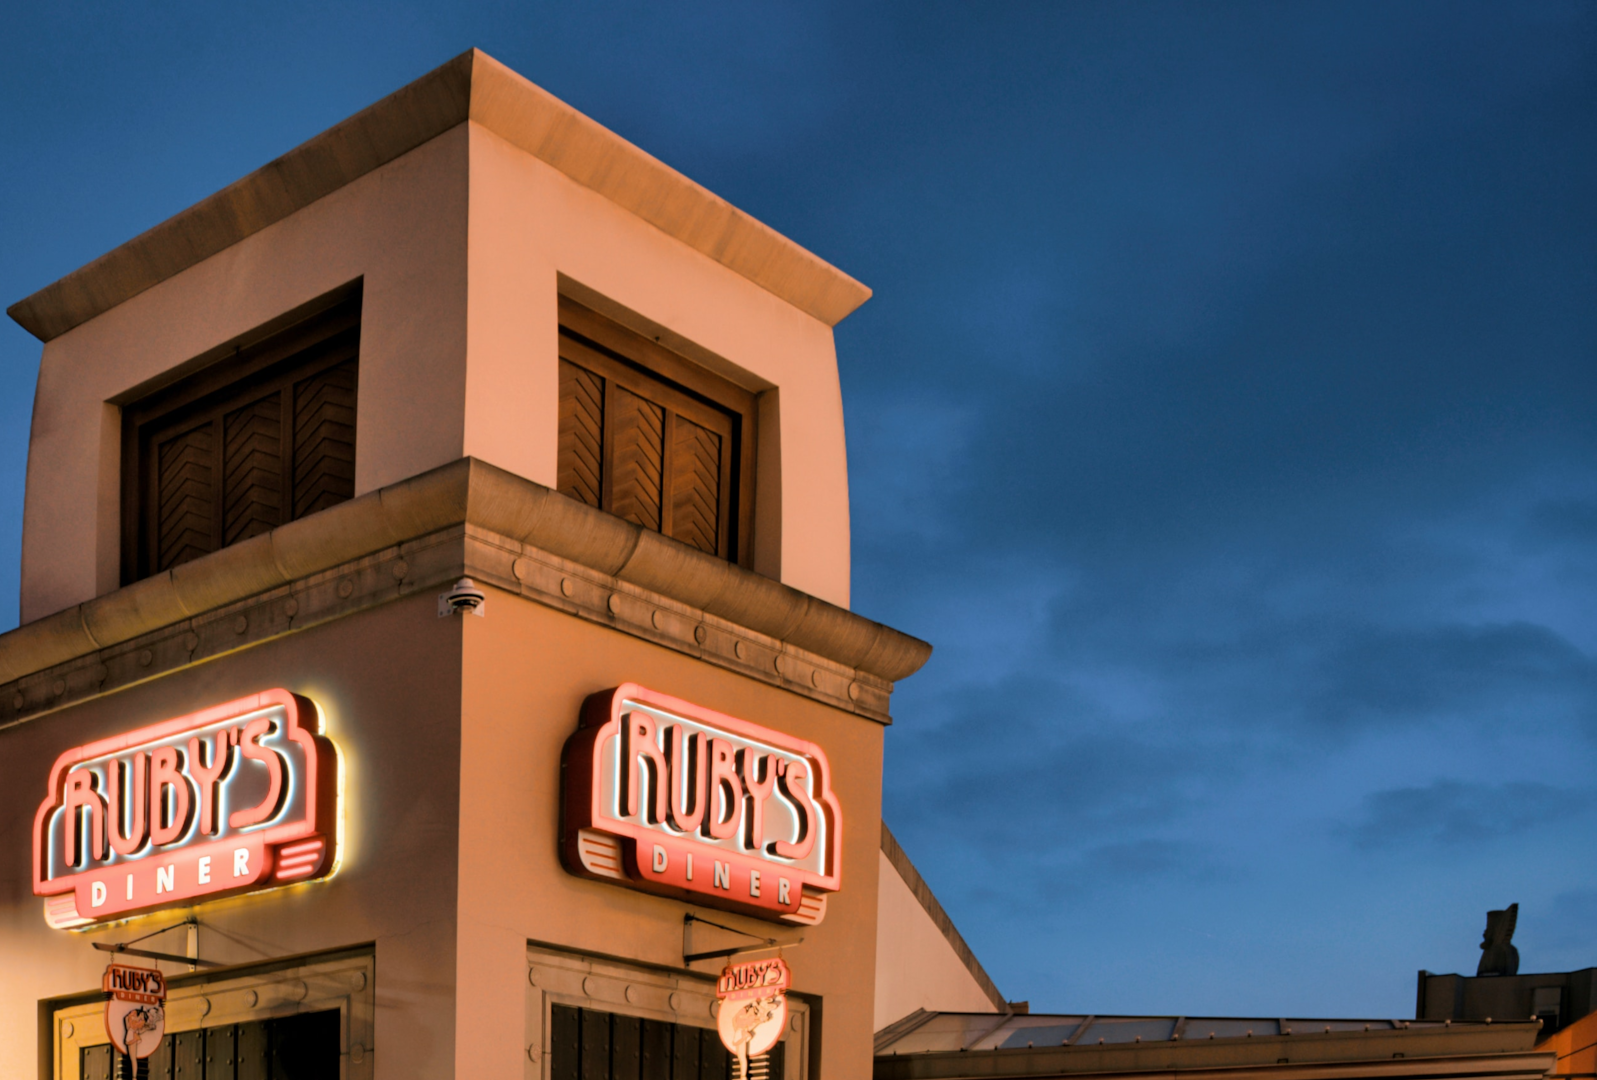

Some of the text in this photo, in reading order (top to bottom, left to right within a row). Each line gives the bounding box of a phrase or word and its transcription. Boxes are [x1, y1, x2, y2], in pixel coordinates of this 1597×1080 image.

[64, 716, 284, 868] RUBY'S
[624, 710, 818, 861] RUBY'S
[91, 847, 252, 910] DINER
[651, 844, 792, 906] DINER
[112, 968, 163, 993] RUBY'S
[120, 991, 157, 1003] DINER
[725, 961, 782, 991] RUBY'S
